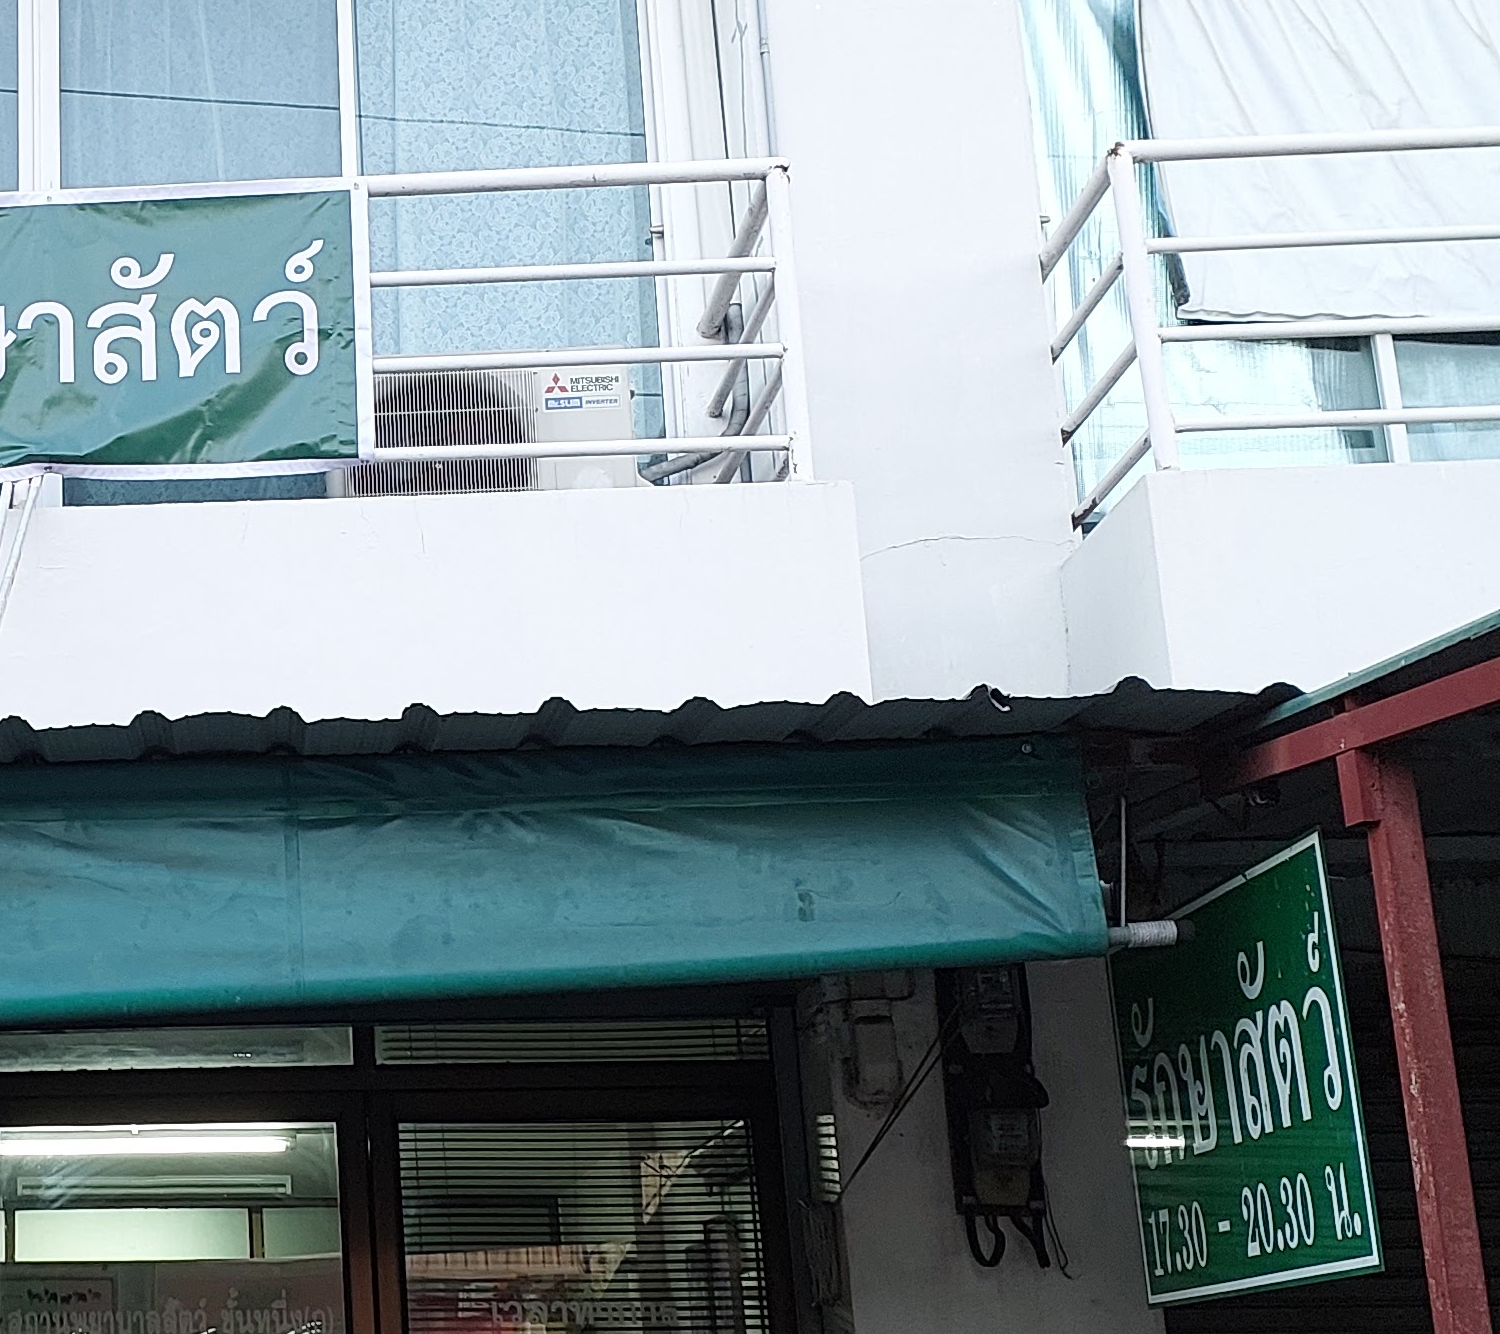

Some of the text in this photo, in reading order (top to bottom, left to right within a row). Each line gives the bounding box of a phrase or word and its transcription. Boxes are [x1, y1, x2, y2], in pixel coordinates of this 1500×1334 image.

[569, 375, 619, 385] MITSUBISHI
[570, 383, 614, 393] ELECTRIC
[1130, 911, 1343, 1170] รักษาสัตว์
[1147, 1200, 1207, 1277] 17.30
[1240, 1173, 1315, 1257] 20.30
[1325, 1163, 1362, 1241] น.
